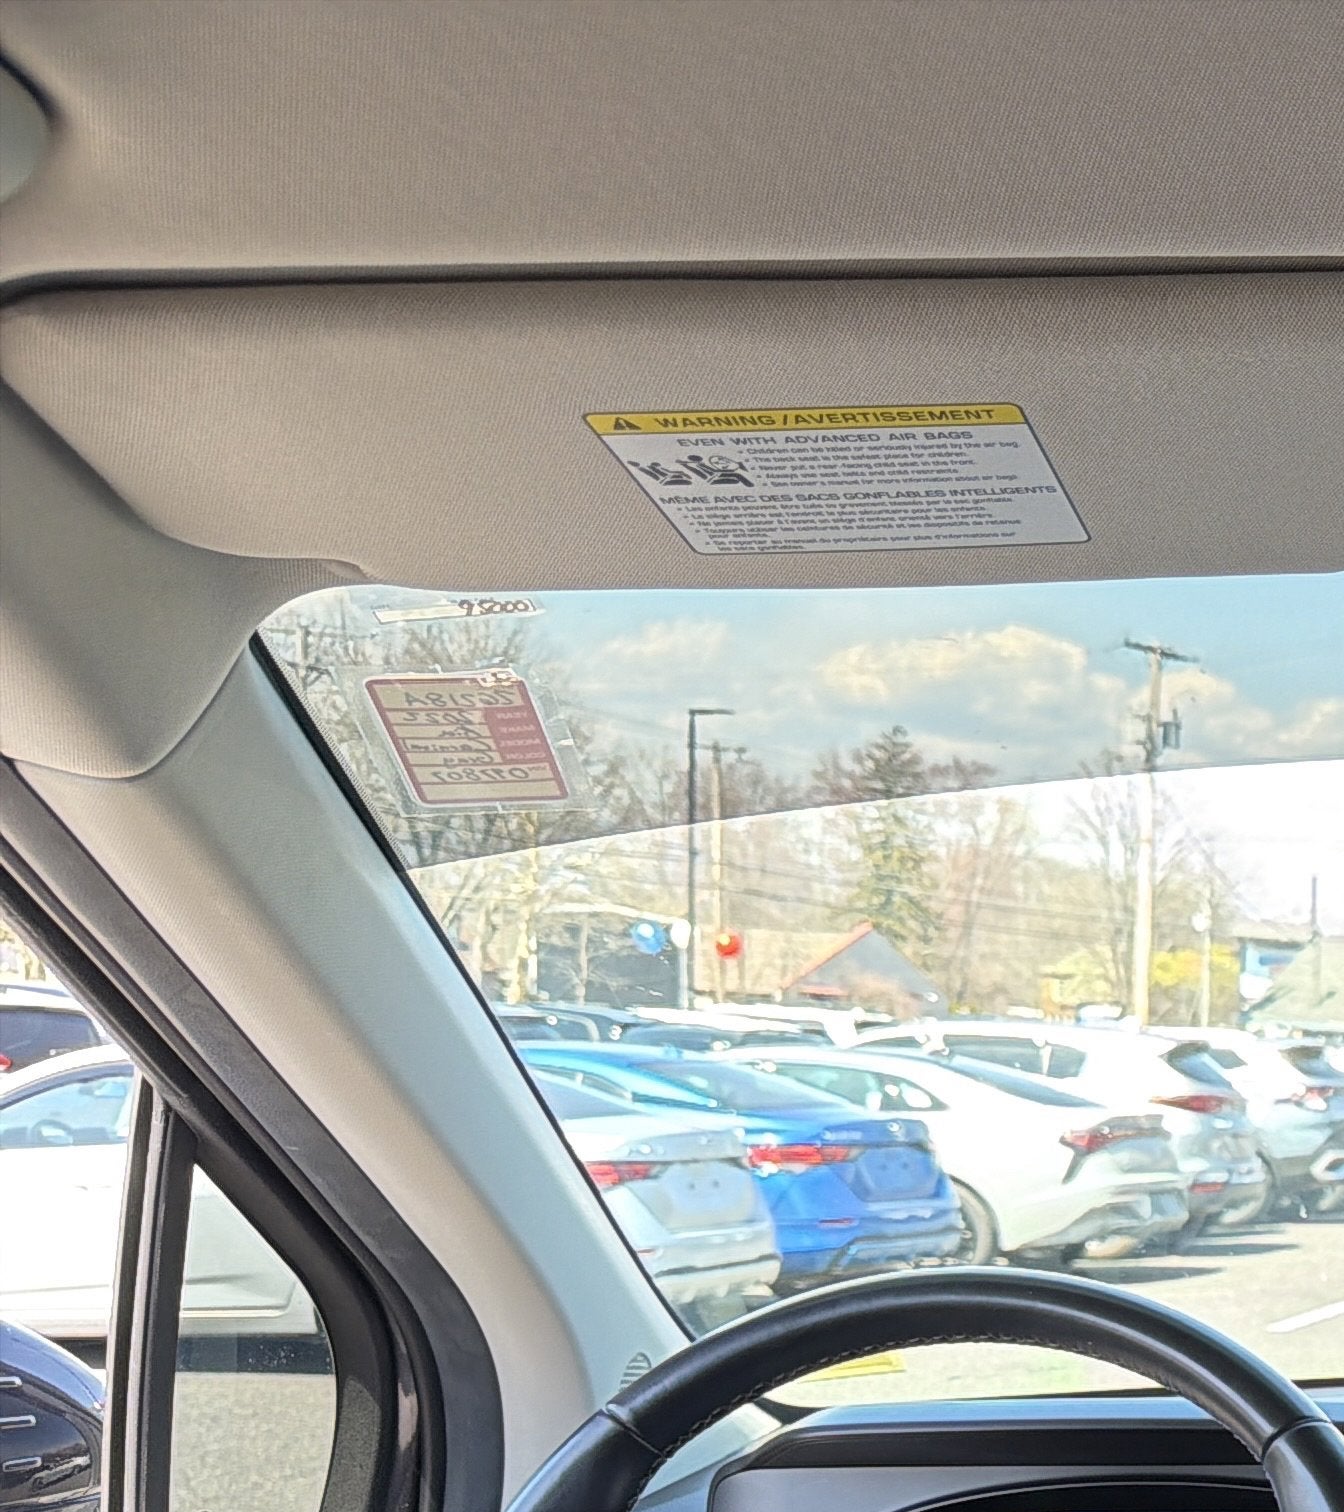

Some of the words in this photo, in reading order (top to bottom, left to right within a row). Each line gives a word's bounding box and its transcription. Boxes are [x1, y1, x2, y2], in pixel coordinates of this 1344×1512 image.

[677, 437, 724, 447] EVEN
[730, 436, 777, 445] WITH
[784, 433, 881, 444] ADVANCED
[888, 432, 918, 441] AIR
[923, 431, 974, 440] BAGS
[660, 492, 710, 505] MÊME
[712, 493, 757, 504] AVEC
[760, 492, 792, 503] DES
[795, 491, 840, 502] SACS
[843, 488, 947, 501] GONFLABLES
[949, 484, 1058, 498] INTELLIGENTS
